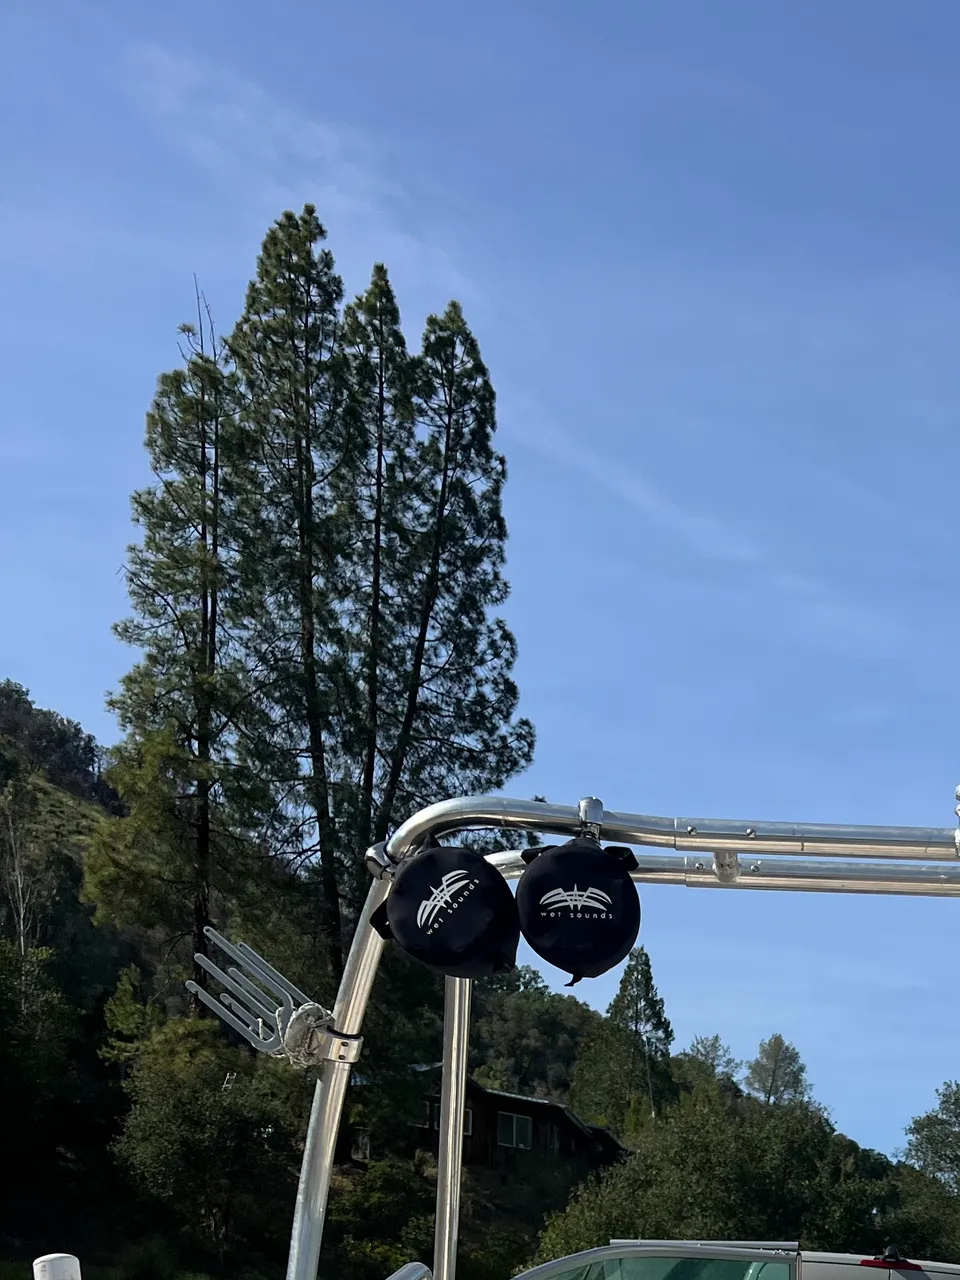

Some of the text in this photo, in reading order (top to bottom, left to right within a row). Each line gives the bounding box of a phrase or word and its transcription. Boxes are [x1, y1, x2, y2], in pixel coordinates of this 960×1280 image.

[425, 878, 480, 935] wet sounds
[569, 911, 613, 920] sounds
